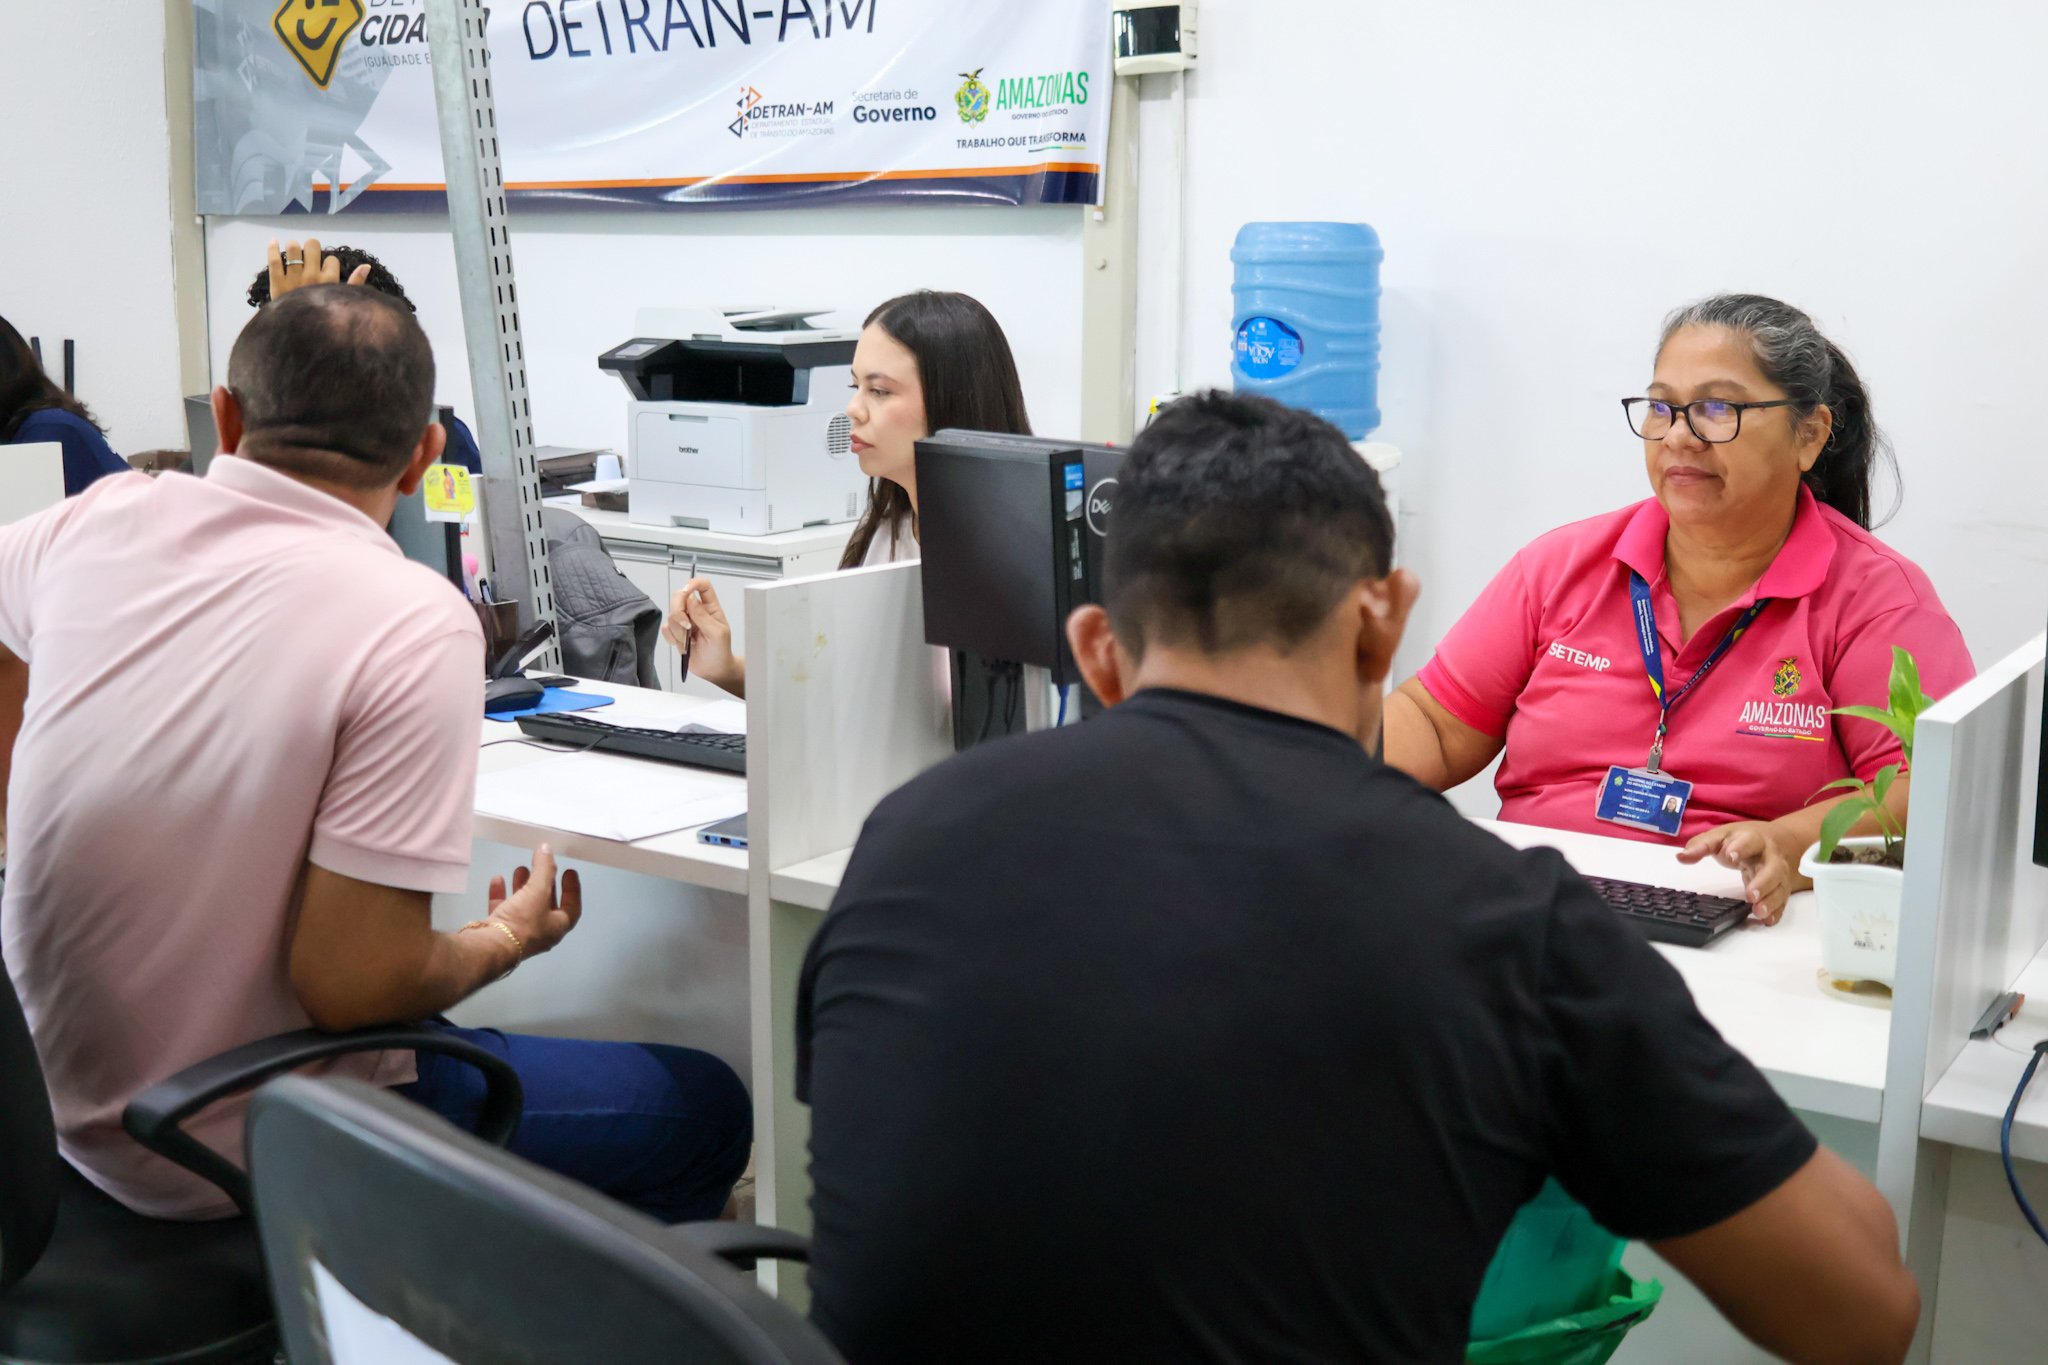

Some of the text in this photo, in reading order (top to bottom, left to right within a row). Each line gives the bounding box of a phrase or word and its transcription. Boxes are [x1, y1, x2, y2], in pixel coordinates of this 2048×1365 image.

[363, 53, 422, 67] IGUALDADE
[852, 88, 918, 102] Secretaria de
[996, 71, 1089, 110] AMAZONAS
[752, 101, 834, 119] DETRAN-AM
[853, 105, 937, 123] Governo
[957, 137, 1006, 149] TRABALHO
[1007, 136, 1027, 147] QUE
[1091, 499, 1112, 515] DE
[1548, 642, 1611, 672] SETEMP
[1738, 701, 1826, 729] AMAZONAS
[1748, 724, 1779, 733] GOVERNO
